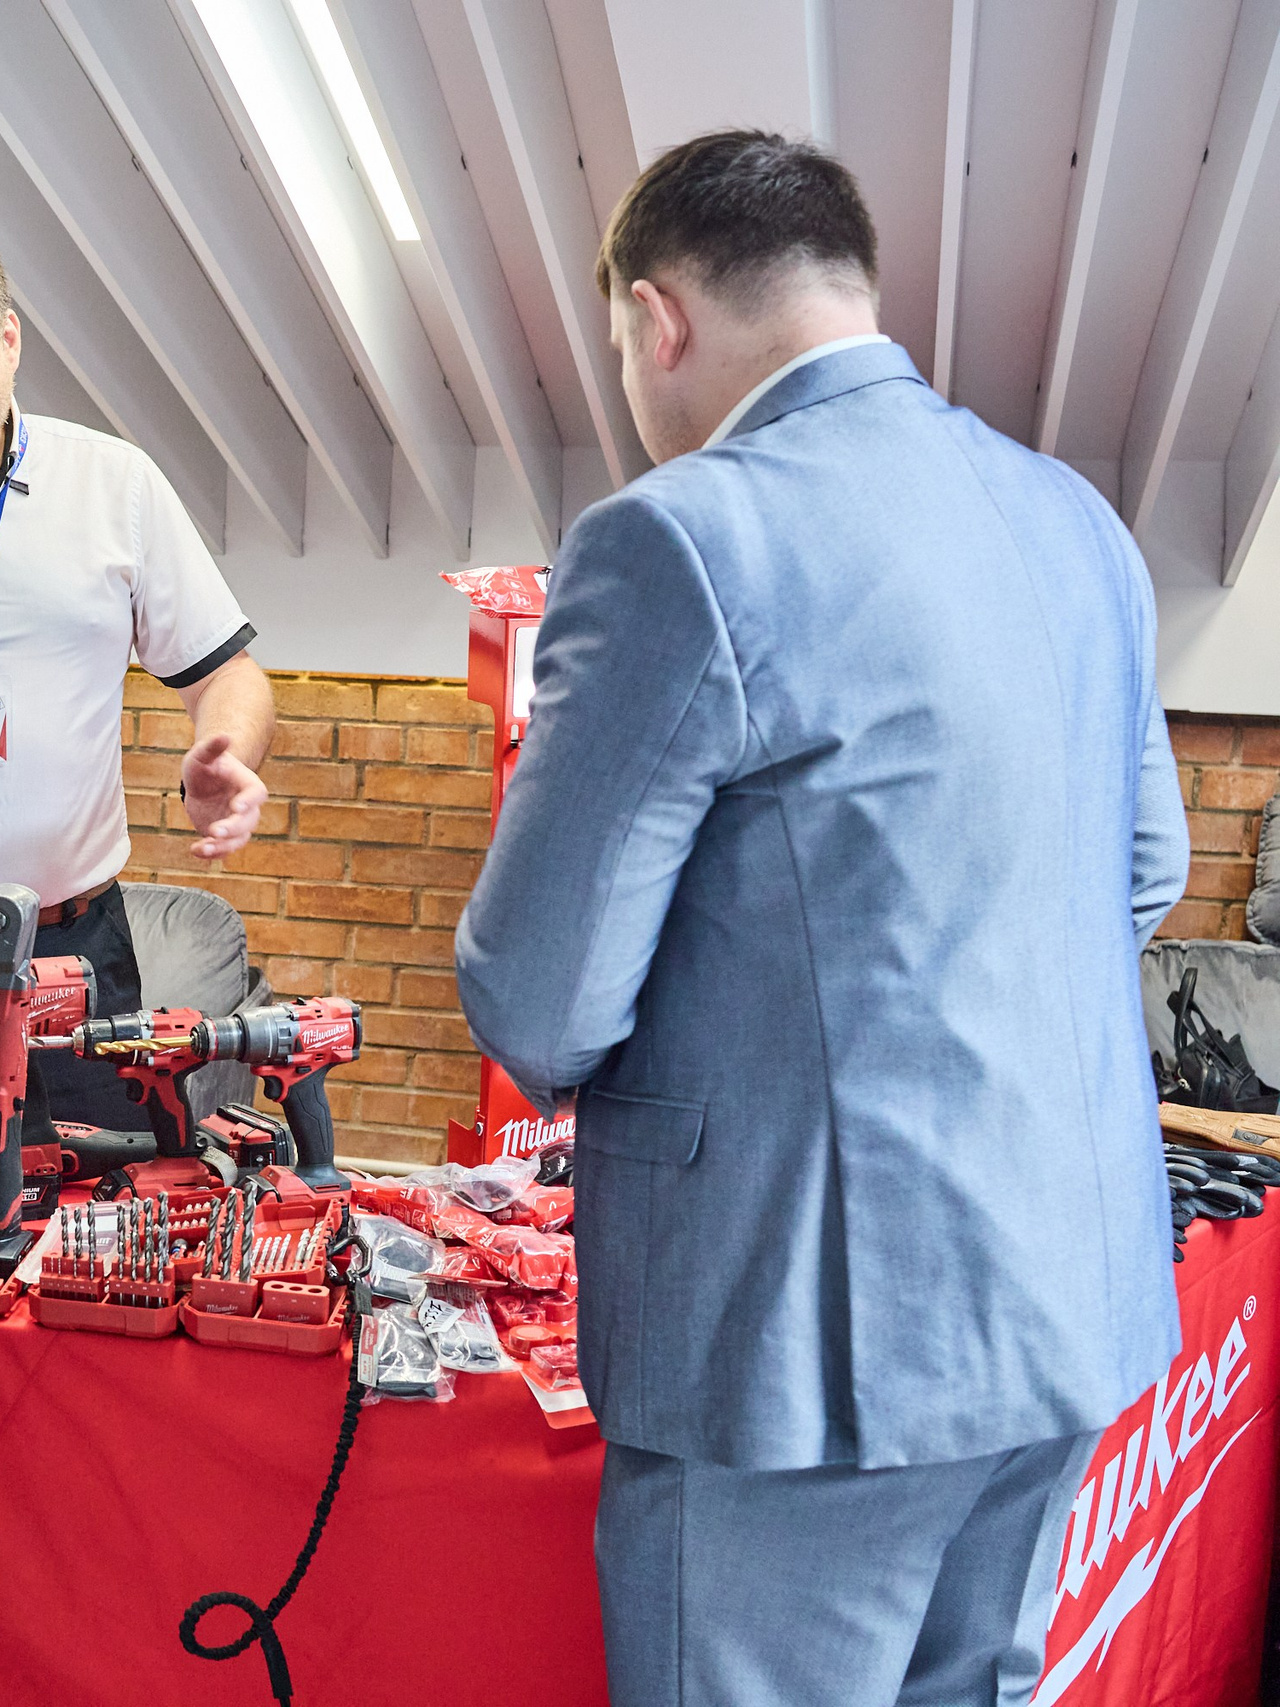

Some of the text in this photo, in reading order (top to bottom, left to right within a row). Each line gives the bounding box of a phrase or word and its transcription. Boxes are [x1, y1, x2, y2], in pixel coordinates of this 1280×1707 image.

[301, 1024, 350, 1045] Milwaukee
[494, 1117, 576, 1158] Milwa
[1047, 1315, 1257, 1632] aukee
